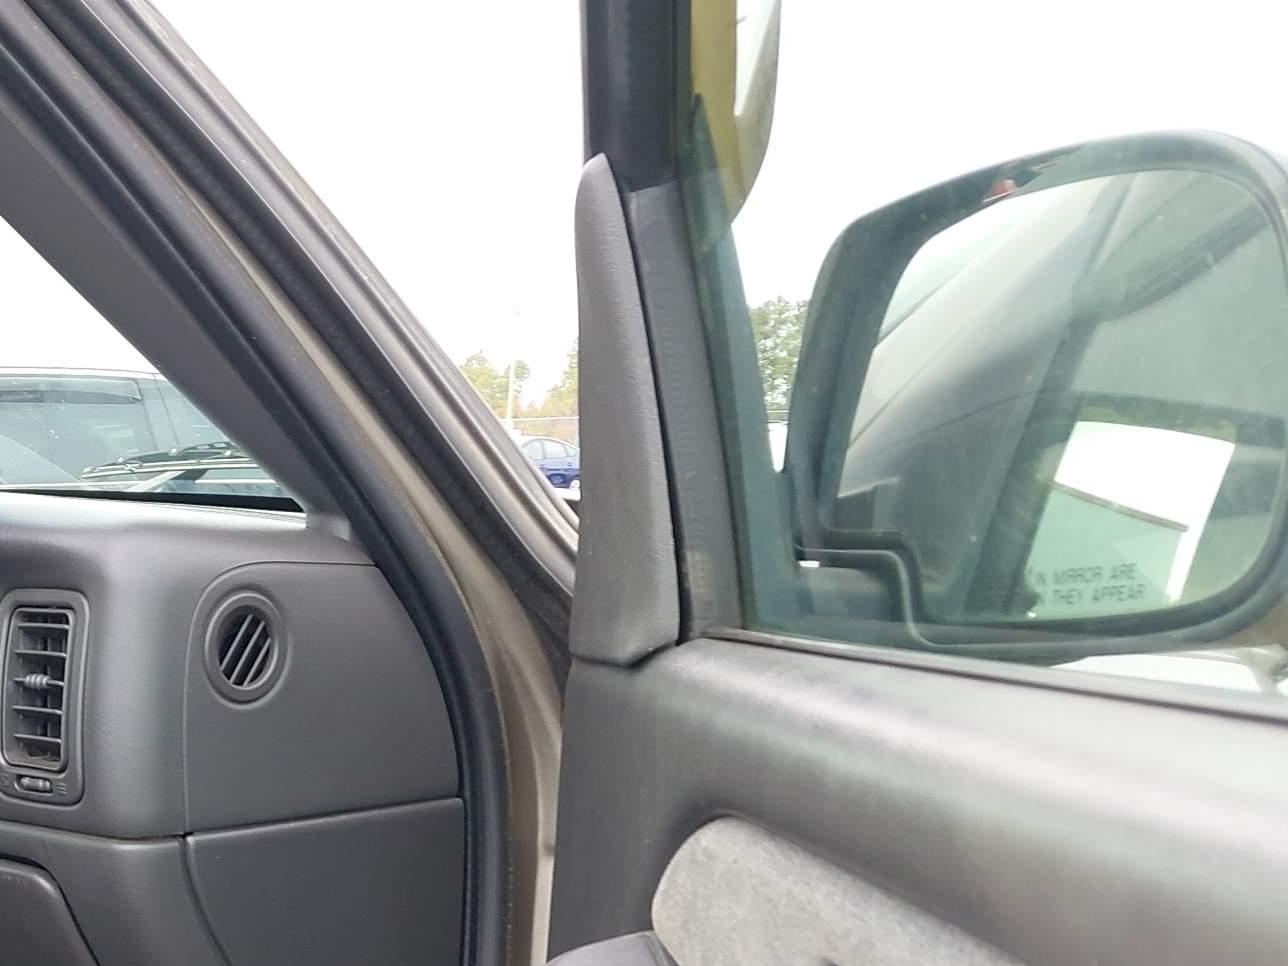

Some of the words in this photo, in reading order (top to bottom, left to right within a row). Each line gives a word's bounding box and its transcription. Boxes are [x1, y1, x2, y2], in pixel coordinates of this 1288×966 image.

[1053, 565, 1103, 585] MIRROR
[1109, 562, 1137, 581] ARE
[1053, 588, 1083, 606] THEY
[1091, 583, 1145, 602] APPEAR
